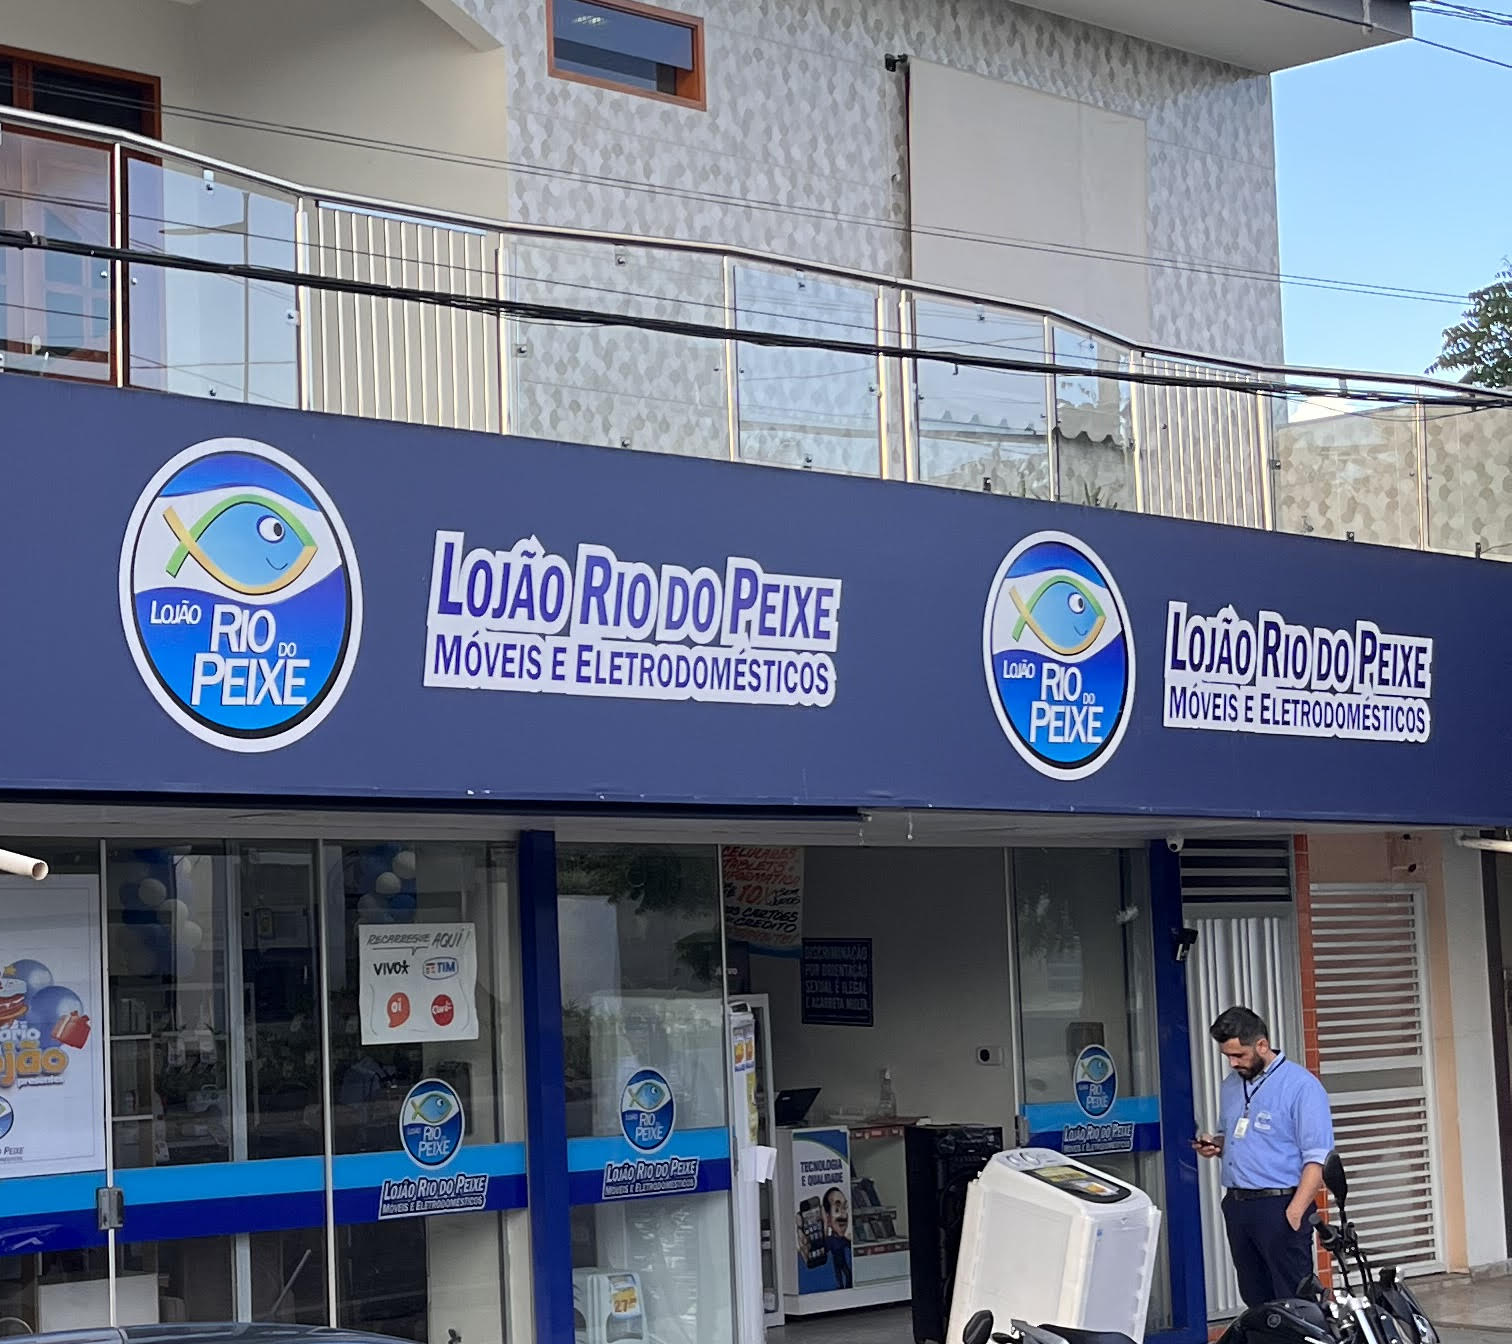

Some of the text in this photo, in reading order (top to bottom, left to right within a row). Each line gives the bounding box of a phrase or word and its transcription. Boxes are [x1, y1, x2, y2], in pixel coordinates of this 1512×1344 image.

[438, 542, 834, 640] LOJÃO RIO DO PEIXE
[150, 600, 296, 657] LOJÃO RIO DO
[1170, 611, 1427, 689] LOJÃO RIO DO PEIXE
[191, 653, 310, 706] PEIXE
[434, 631, 828, 695] MÓVEIS E ELETRODOMÉSTICOS
[1003, 659, 1036, 679] LOJÃO
[1041, 662, 1082, 702] RIO
[1029, 701, 1104, 743] PEIXE
[1169, 682, 1426, 734] MÓVEIS E ELETRODOMÉSTICOS
[437, 961, 455, 973] TIM
[418, 1179, 436, 1197] RIO
[439, 1179, 454, 1195] DO
[455, 1175, 485, 1194] PEIXE
